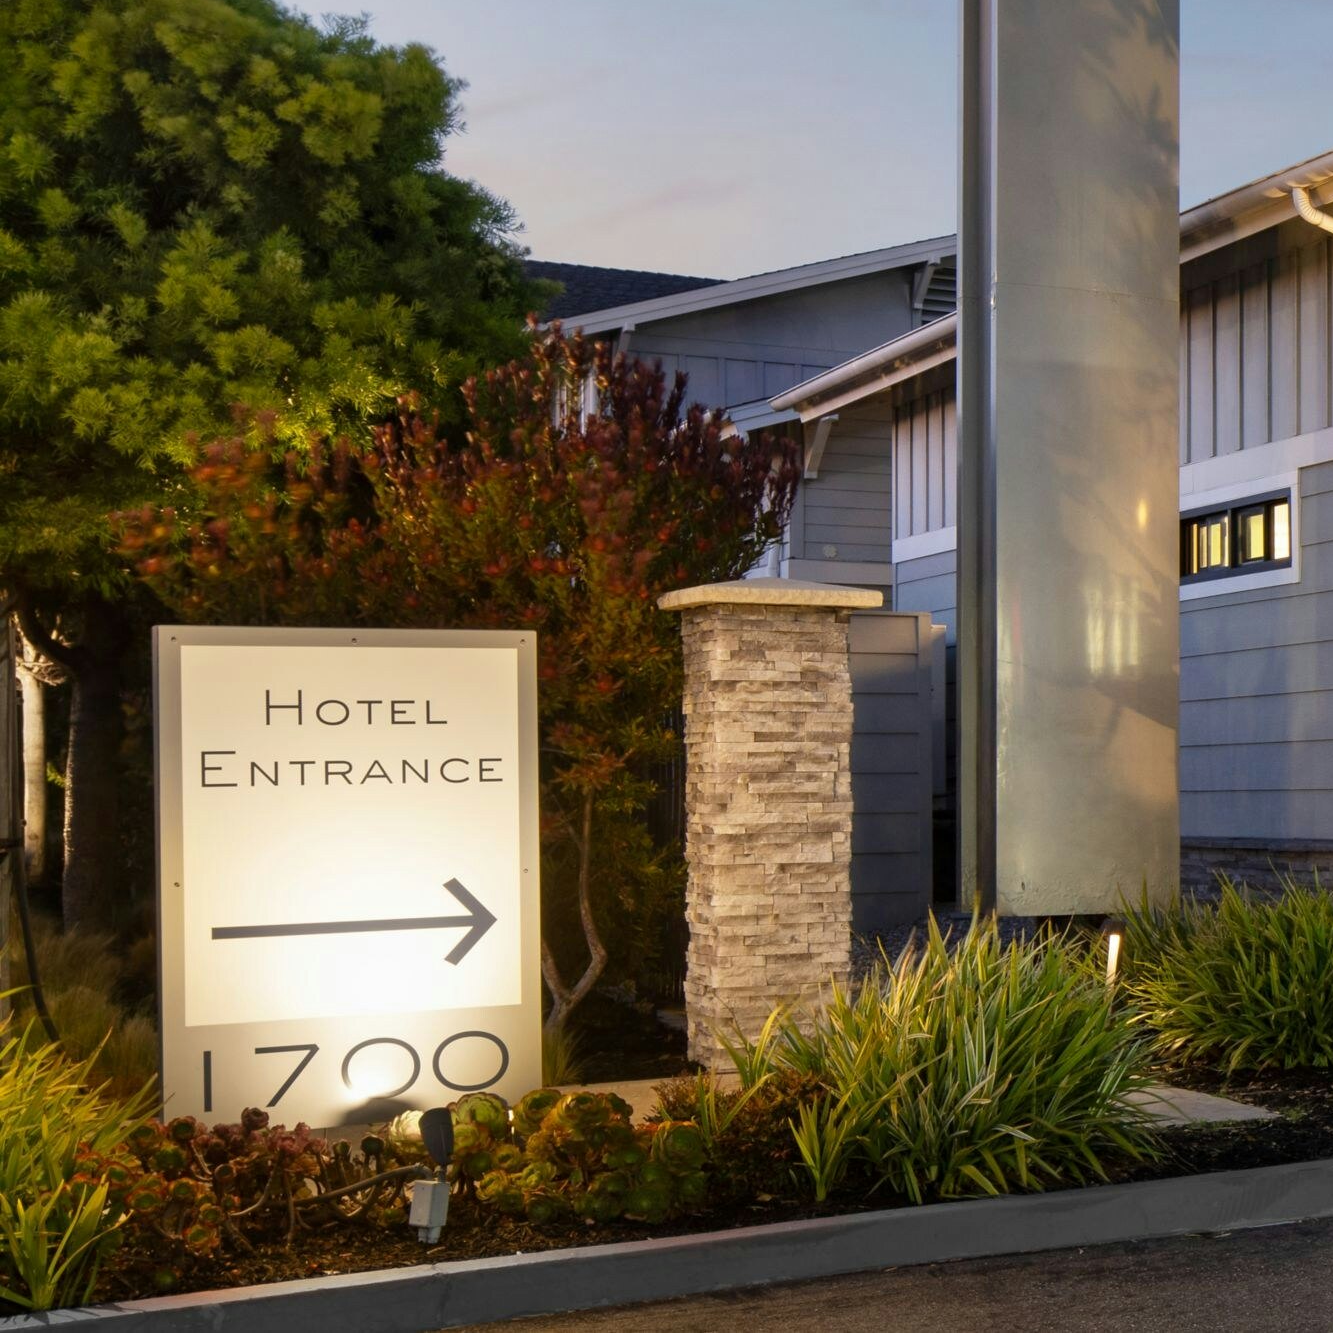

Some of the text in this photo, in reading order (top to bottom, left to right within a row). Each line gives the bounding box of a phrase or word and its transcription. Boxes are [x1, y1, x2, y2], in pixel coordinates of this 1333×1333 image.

[264, 688, 449, 726] HOTEL
[200, 749, 504, 788] ENTRANCE
[202, 1030, 509, 1113] 1700
